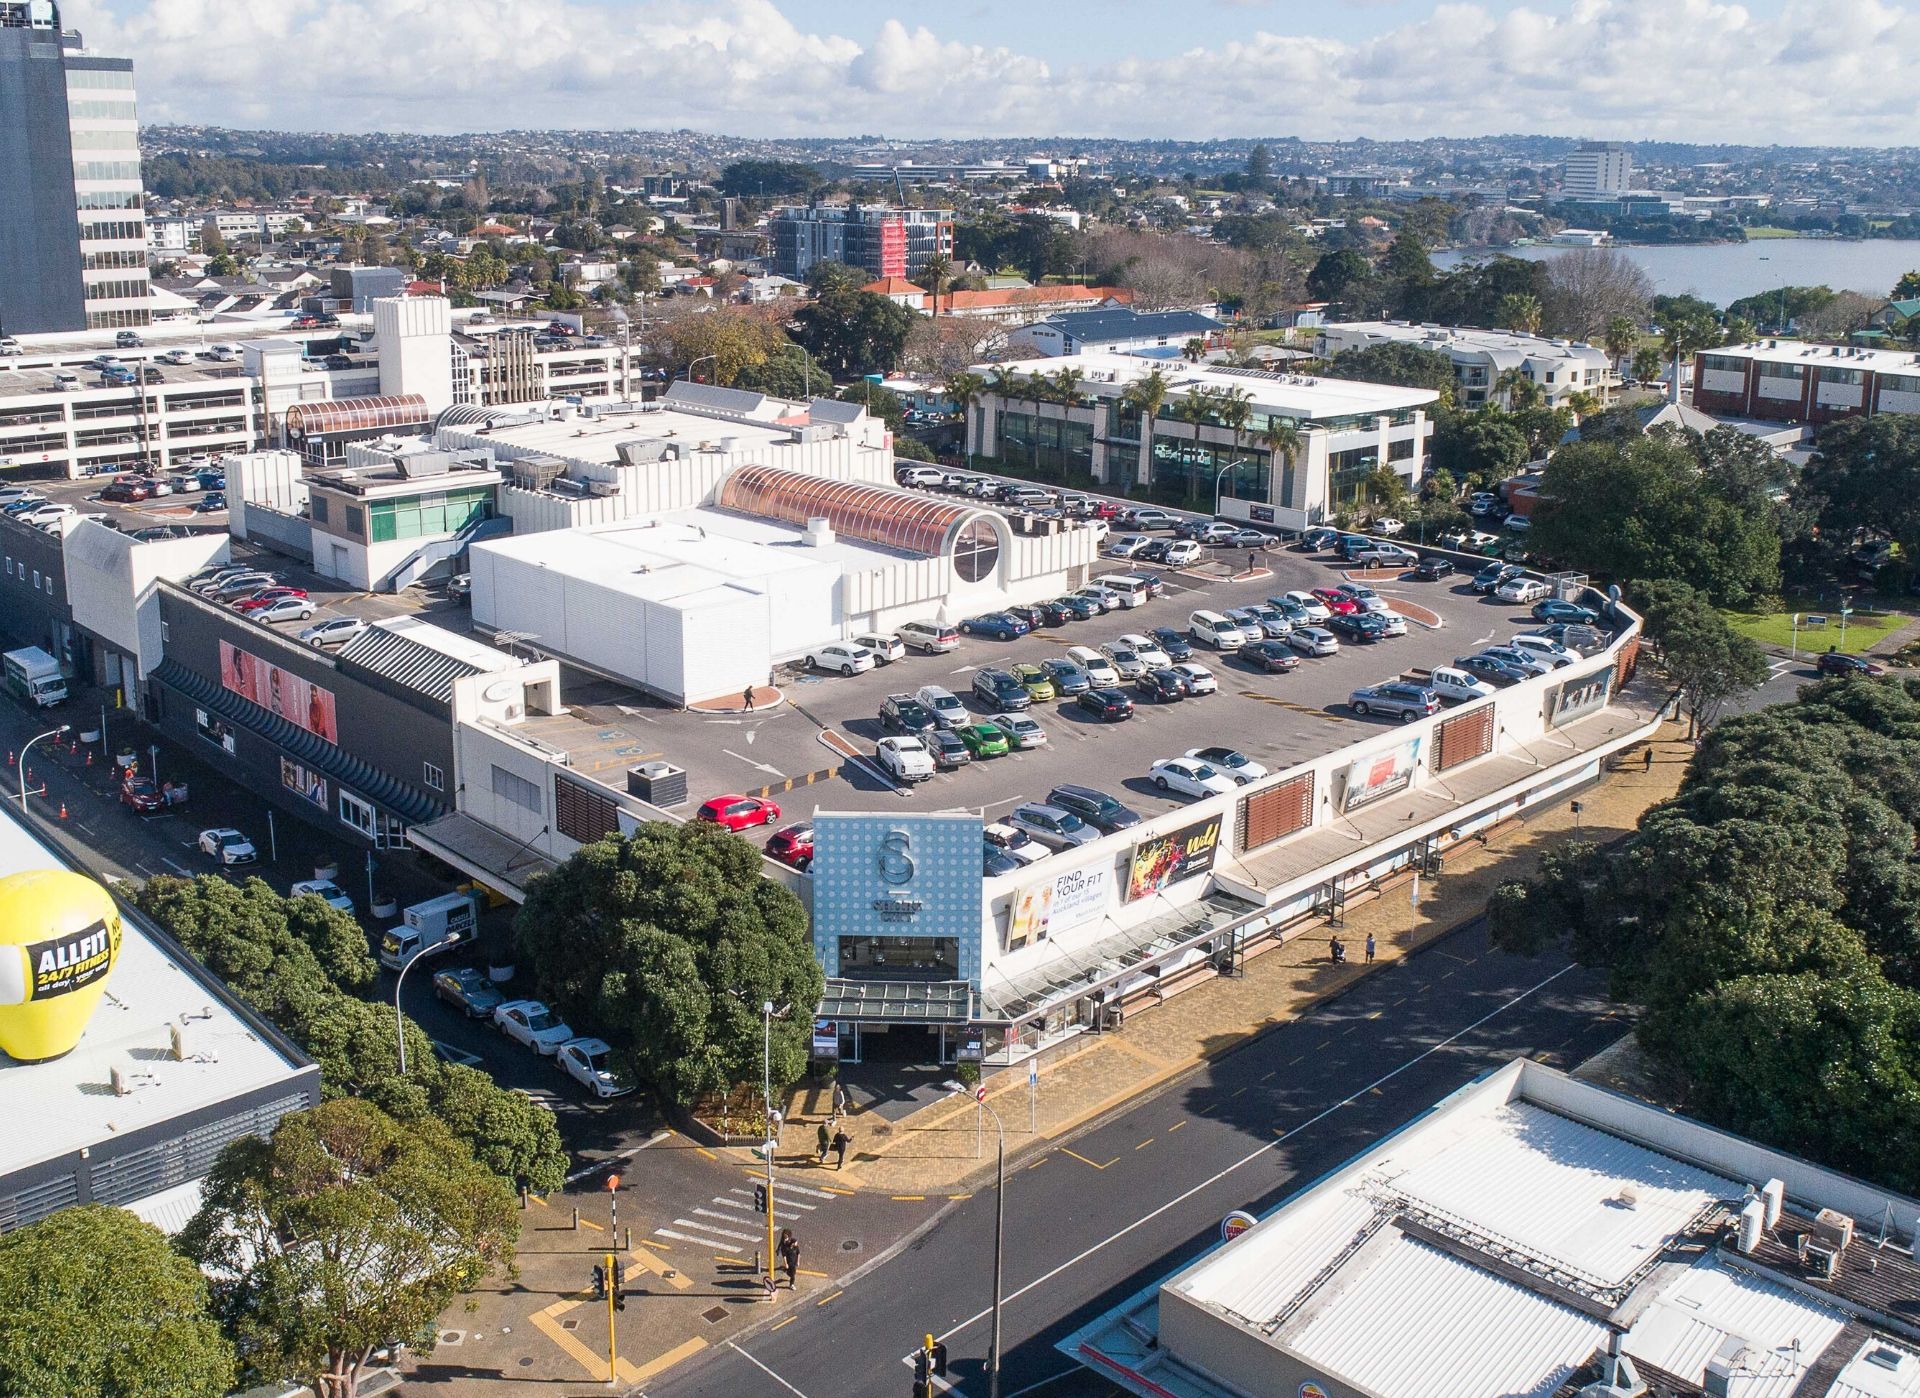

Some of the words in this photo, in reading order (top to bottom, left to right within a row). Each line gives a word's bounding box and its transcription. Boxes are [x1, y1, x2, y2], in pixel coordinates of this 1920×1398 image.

[1056, 870, 1082, 889] FIND
[1056, 879, 1085, 898] YOUR
[1087, 872, 1104, 889] FIT
[37, 928, 107, 974] ALLFIT
[37, 966, 74, 985] 24/7
[75, 948, 110, 974] FITNESS
[38, 982, 51, 992] all
[52, 978, 71, 989] day
